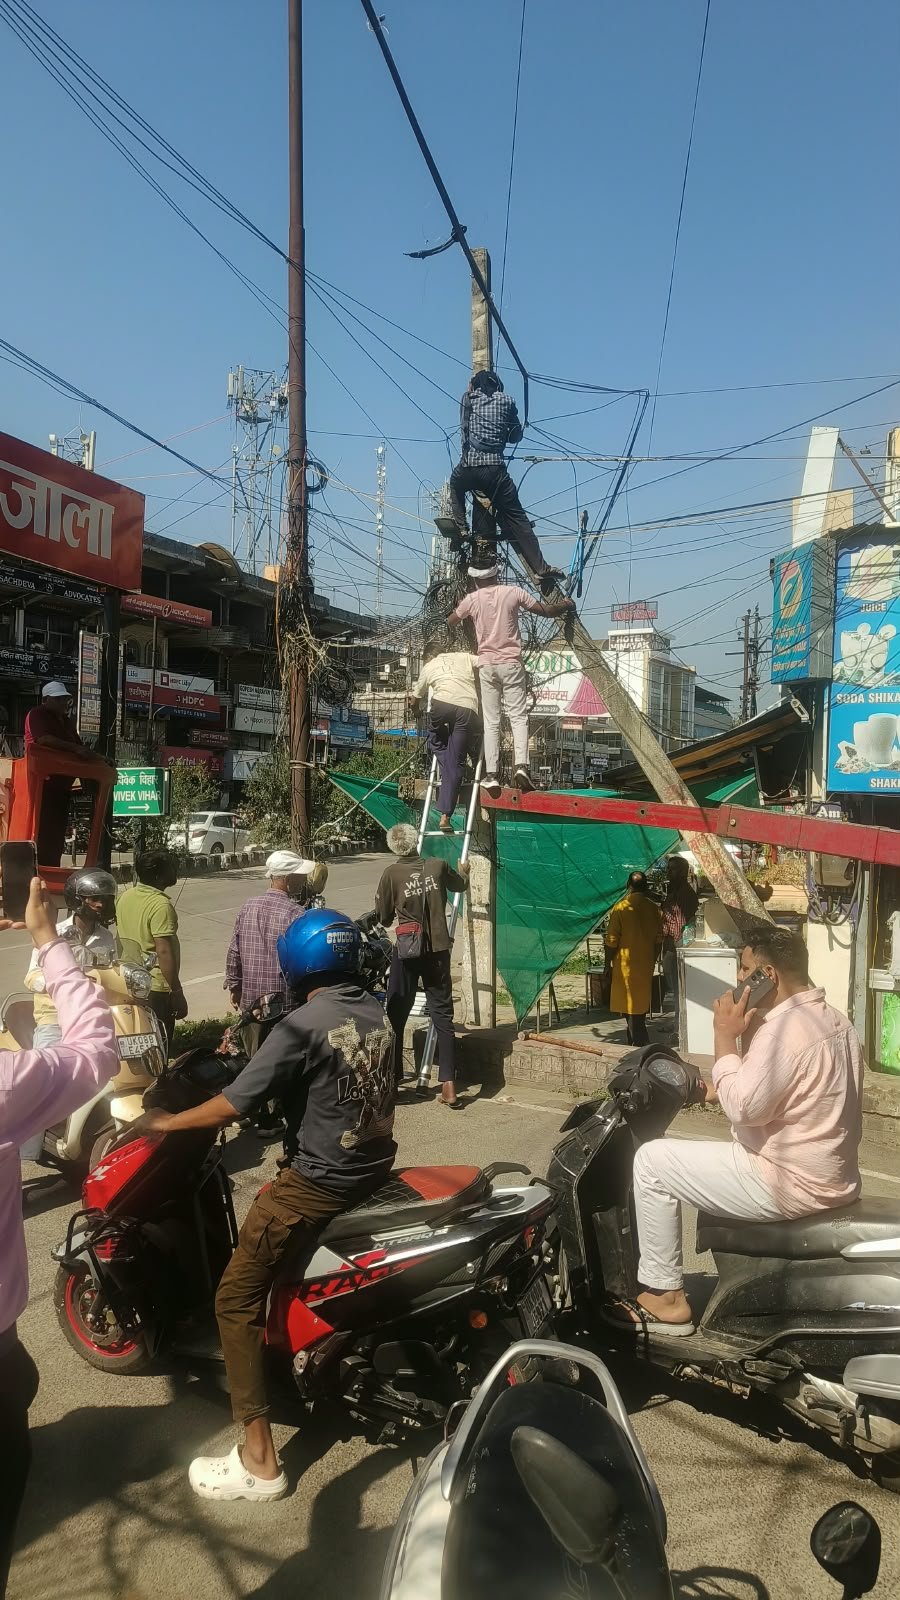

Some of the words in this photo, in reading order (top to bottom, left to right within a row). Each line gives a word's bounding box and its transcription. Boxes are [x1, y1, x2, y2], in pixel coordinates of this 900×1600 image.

[0, 575, 36, 590] SACHDEVA
[63, 589, 101, 604] ADVOCATES
[860, 602, 887, 612] JUICE
[616, 635, 646, 643] HOTEL
[610, 642, 650, 651] VINAYAK
[127, 670, 138, 678] Life
[182, 695, 205, 706] HDFC
[836, 692, 865, 704] SODA
[113, 790, 136, 802] VIVEK
[137, 790, 161, 801] VIHAR
[405, 874, 435, 890] Wi-Fi
[402, 1416, 421, 1427] TVS
